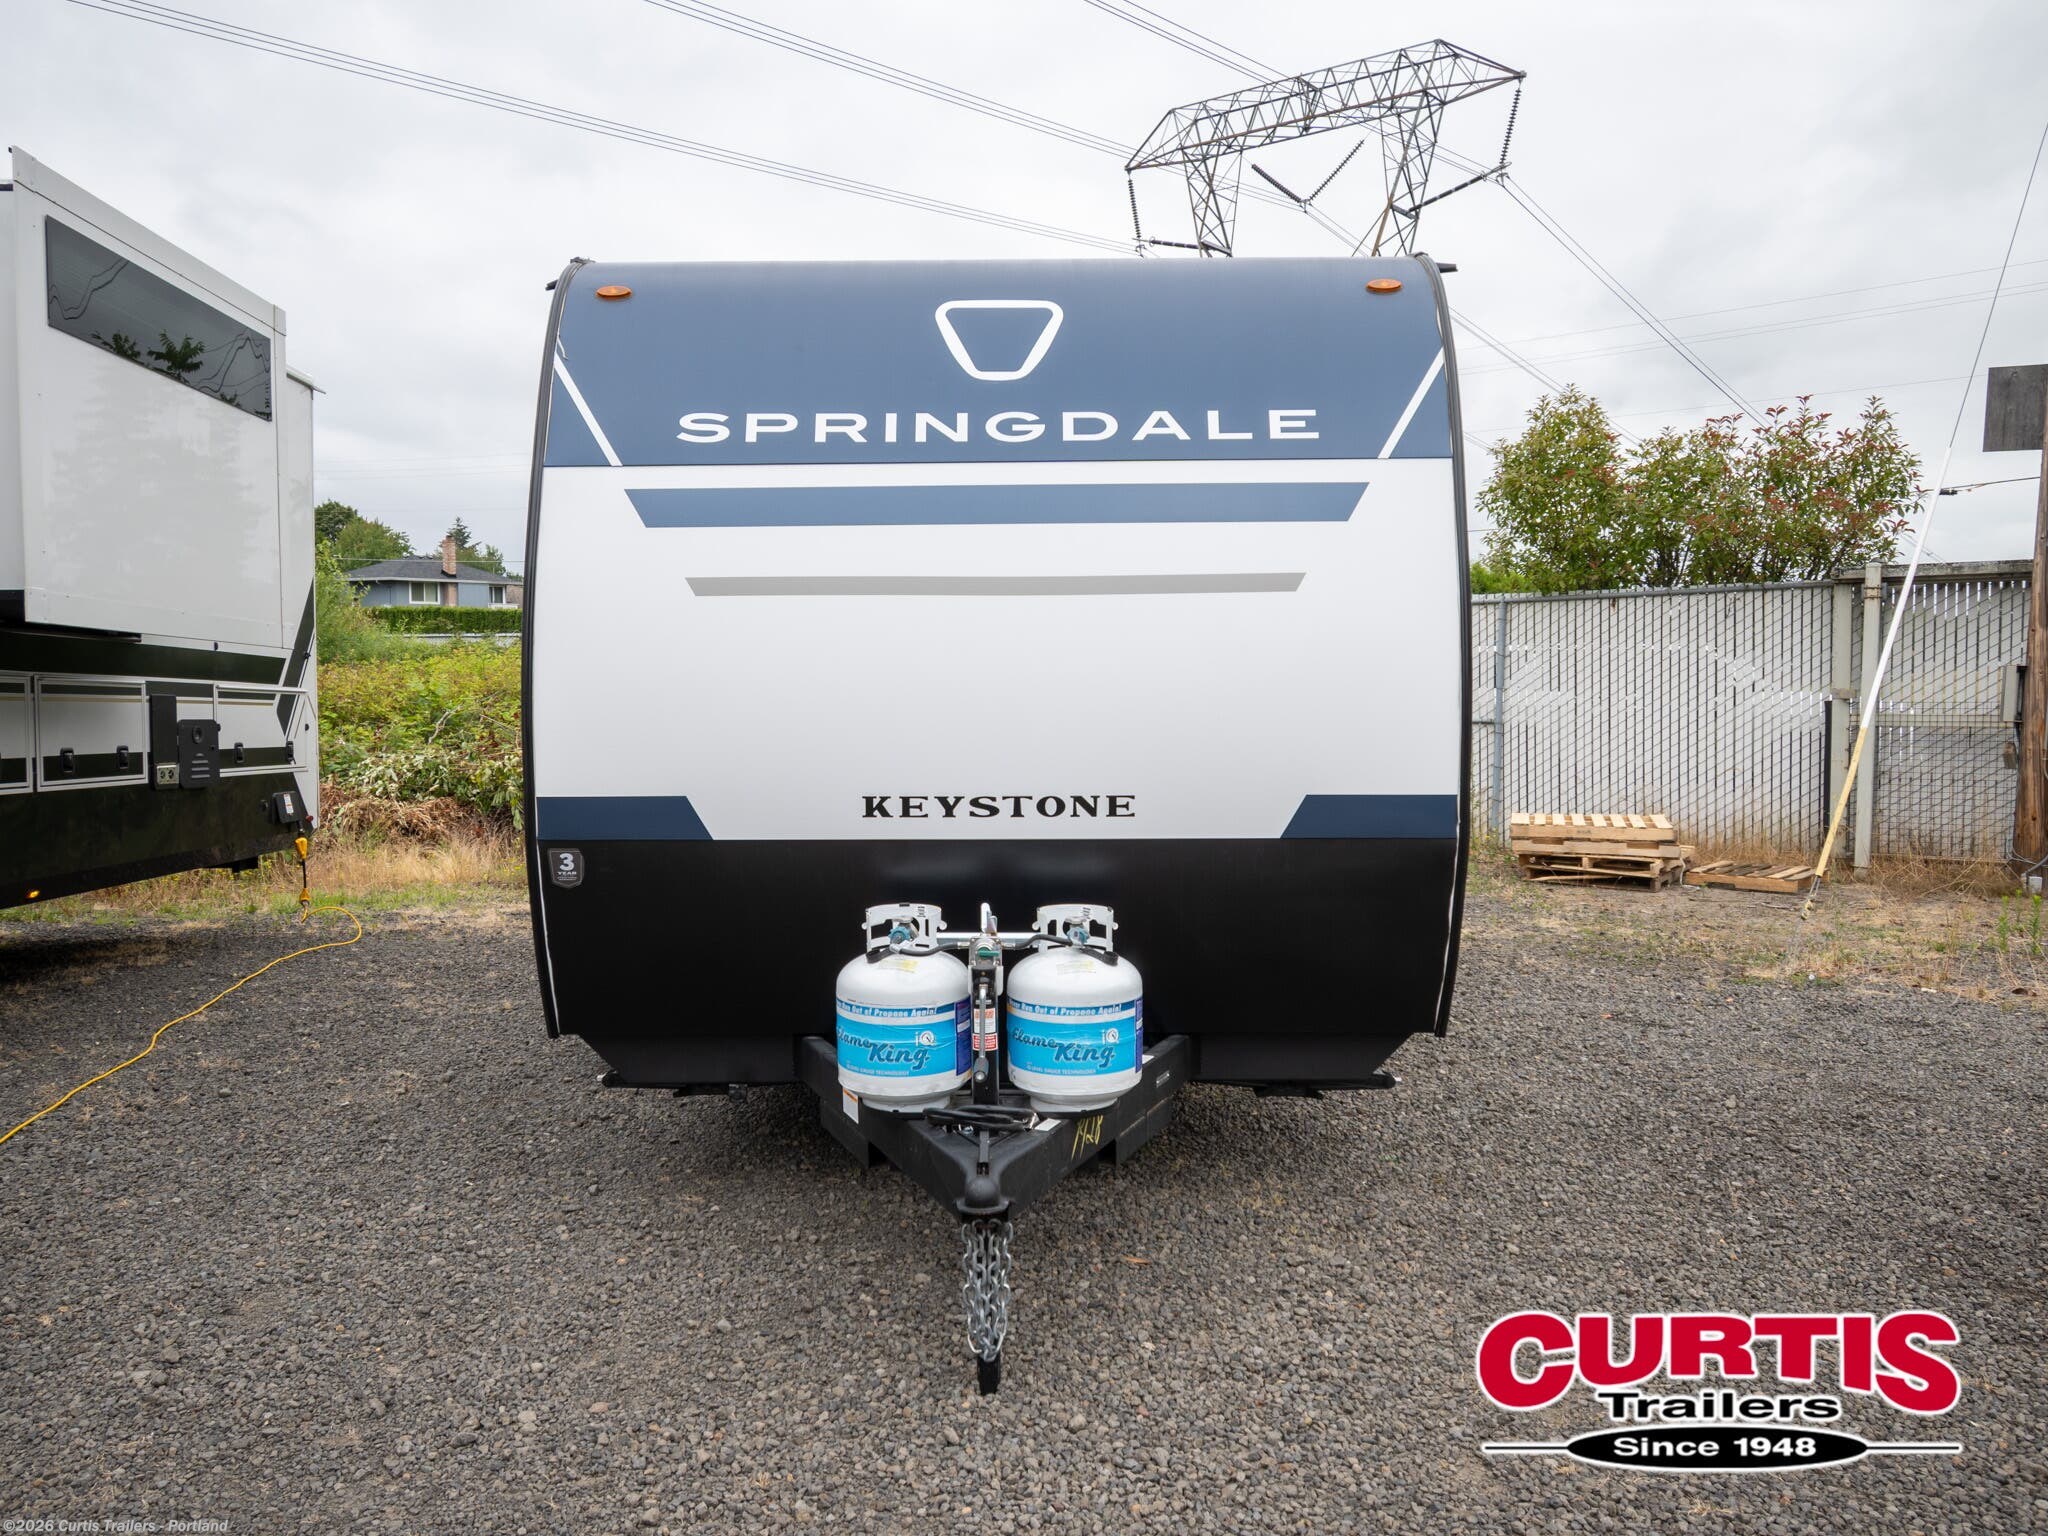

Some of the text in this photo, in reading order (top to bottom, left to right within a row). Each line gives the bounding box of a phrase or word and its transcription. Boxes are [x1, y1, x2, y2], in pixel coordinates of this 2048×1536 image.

[676, 408, 1321, 444] SPRINGDALE
[862, 795, 1136, 818] KEYSTONE
[559, 852, 575, 871] 3
[874, 1008, 909, 1018] Propane
[1061, 1006, 1096, 1017] Propane
[868, 1042, 930, 1071] King
[1054, 1041, 1115, 1069] King
